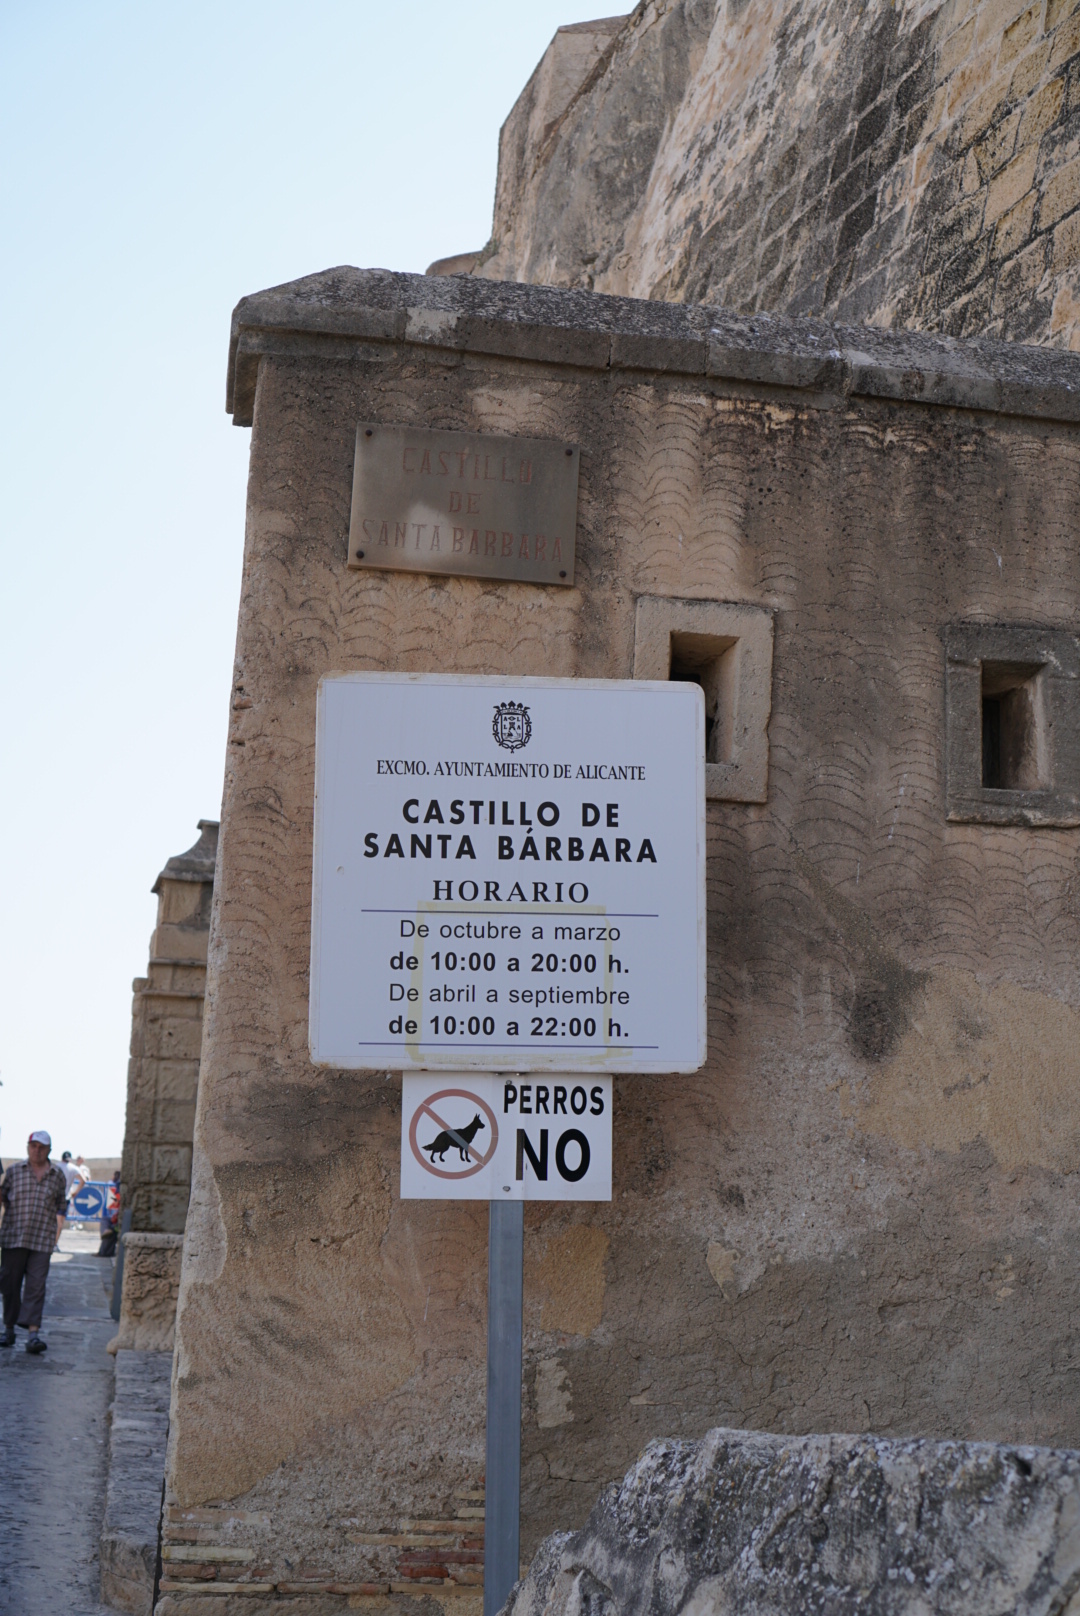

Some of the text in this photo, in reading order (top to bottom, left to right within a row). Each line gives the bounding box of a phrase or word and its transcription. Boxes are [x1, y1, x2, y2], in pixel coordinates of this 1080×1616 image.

[403, 447, 532, 484] CASTILLO
[448, 490, 482, 514] DE
[361, 519, 562, 562] SANTA BARBARA
[377, 759, 645, 780] EXCMO. AYUNTAMIENTO DE ALICANTE
[403, 799, 619, 827] CASTILLO DE
[364, 829, 657, 863] SANTA BÁRBARA
[433, 880, 588, 903] HORARIO
[401, 920, 620, 941] De octubre a marzo
[390, 951, 628, 973] de 10:00 a 20:00 h.
[390, 984, 629, 1007] De abril a septiembre
[389, 1015, 628, 1037] de 10:00 a 22:00 h.
[504, 1084, 604, 1115] PERROS
[516, 1129, 590, 1182] NO
